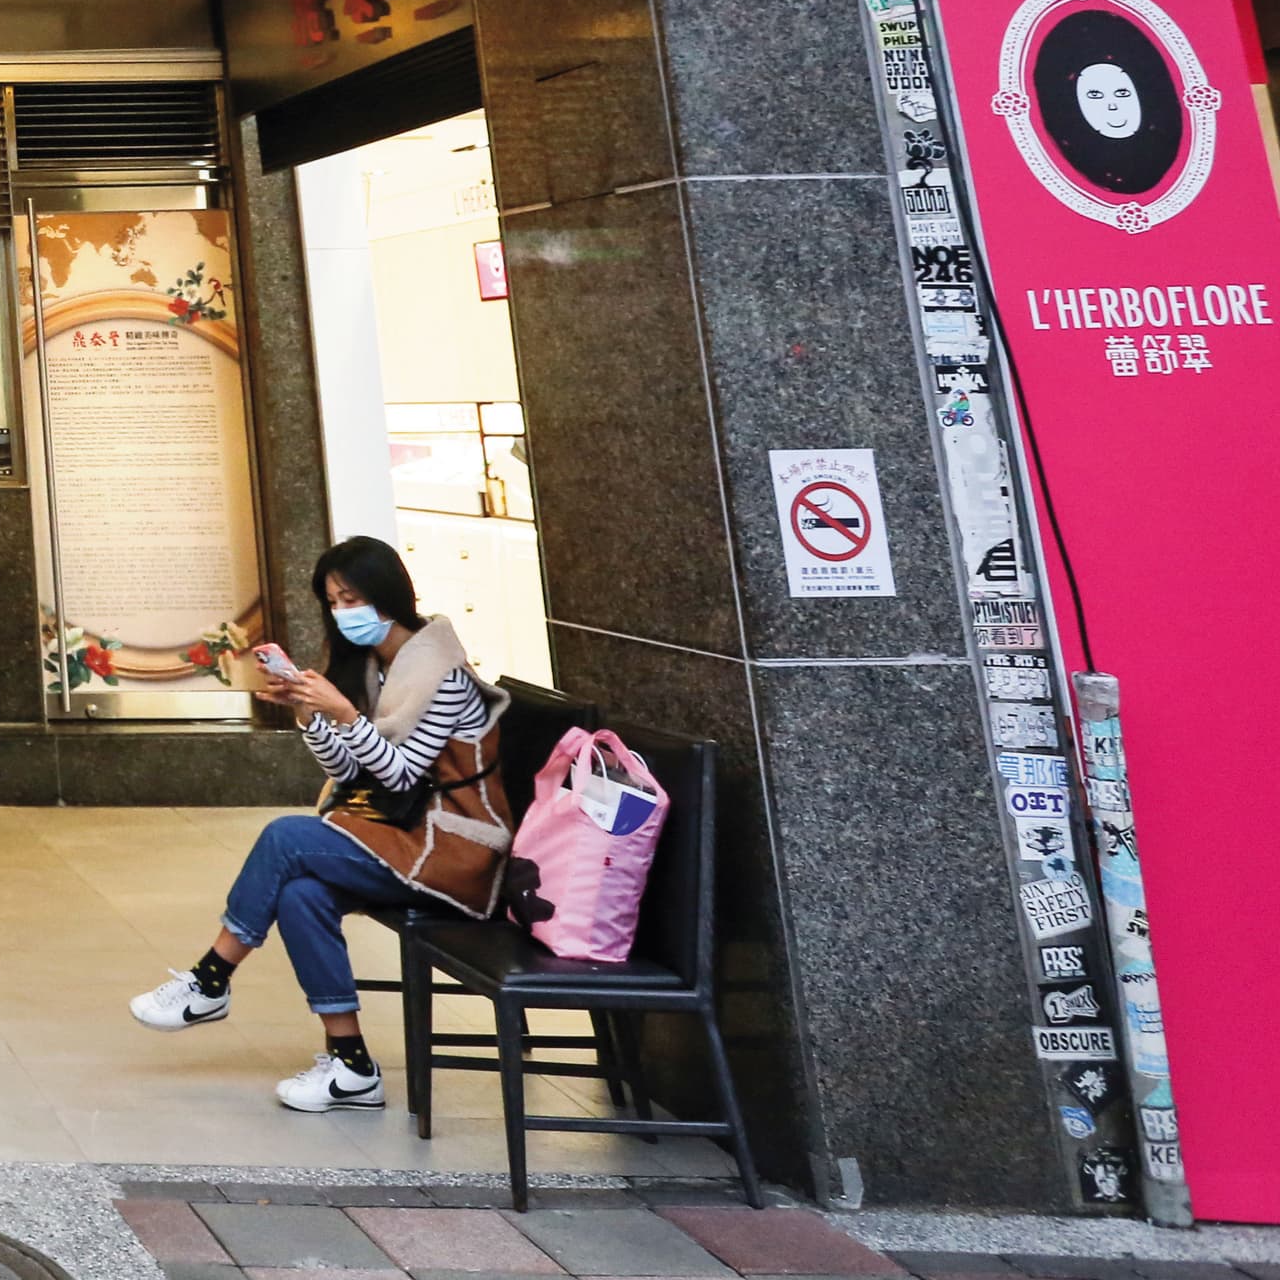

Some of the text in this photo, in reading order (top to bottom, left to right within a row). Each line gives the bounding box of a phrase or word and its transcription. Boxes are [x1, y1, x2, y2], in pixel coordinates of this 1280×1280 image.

[1026, 284, 1274, 330] L'HERBOFLORE
[1104, 334, 1213, 377] 蕾舒翠
[978, 627, 1039, 646] 你看到了
[1026, 888, 1089, 917] SAFETY
[1034, 905, 1090, 931] FIRST
[1040, 1030, 1111, 1051] OBSCURE
